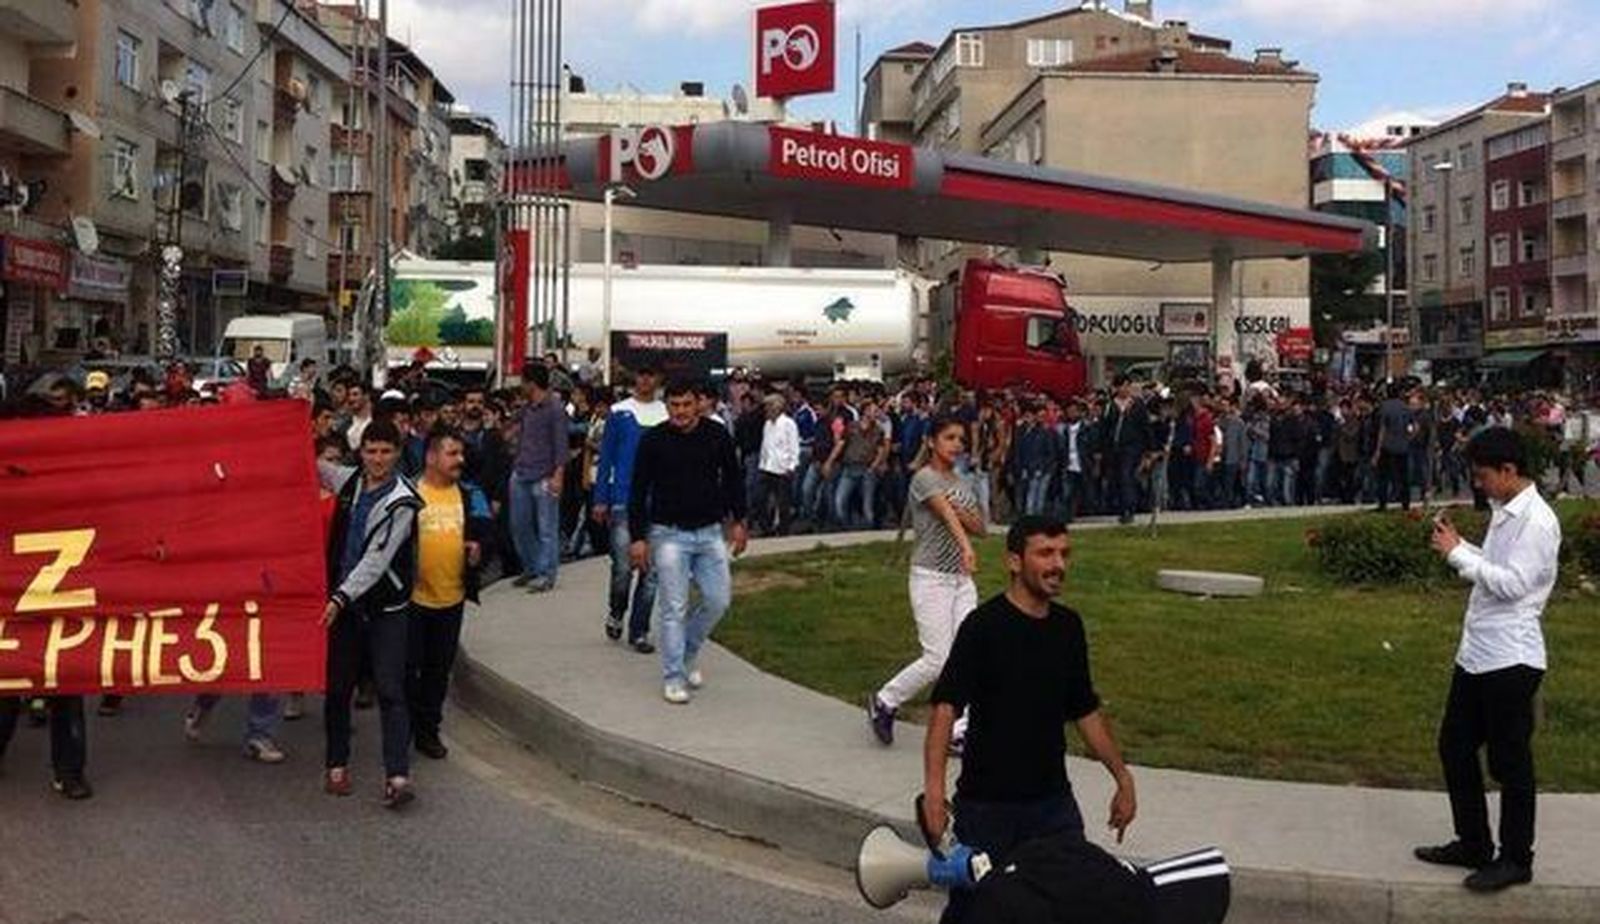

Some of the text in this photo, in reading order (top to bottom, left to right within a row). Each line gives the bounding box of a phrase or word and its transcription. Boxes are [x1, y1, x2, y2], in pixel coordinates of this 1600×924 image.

[782, 138, 899, 178] Petrol Ofisi
[13, 527, 97, 613] Z
